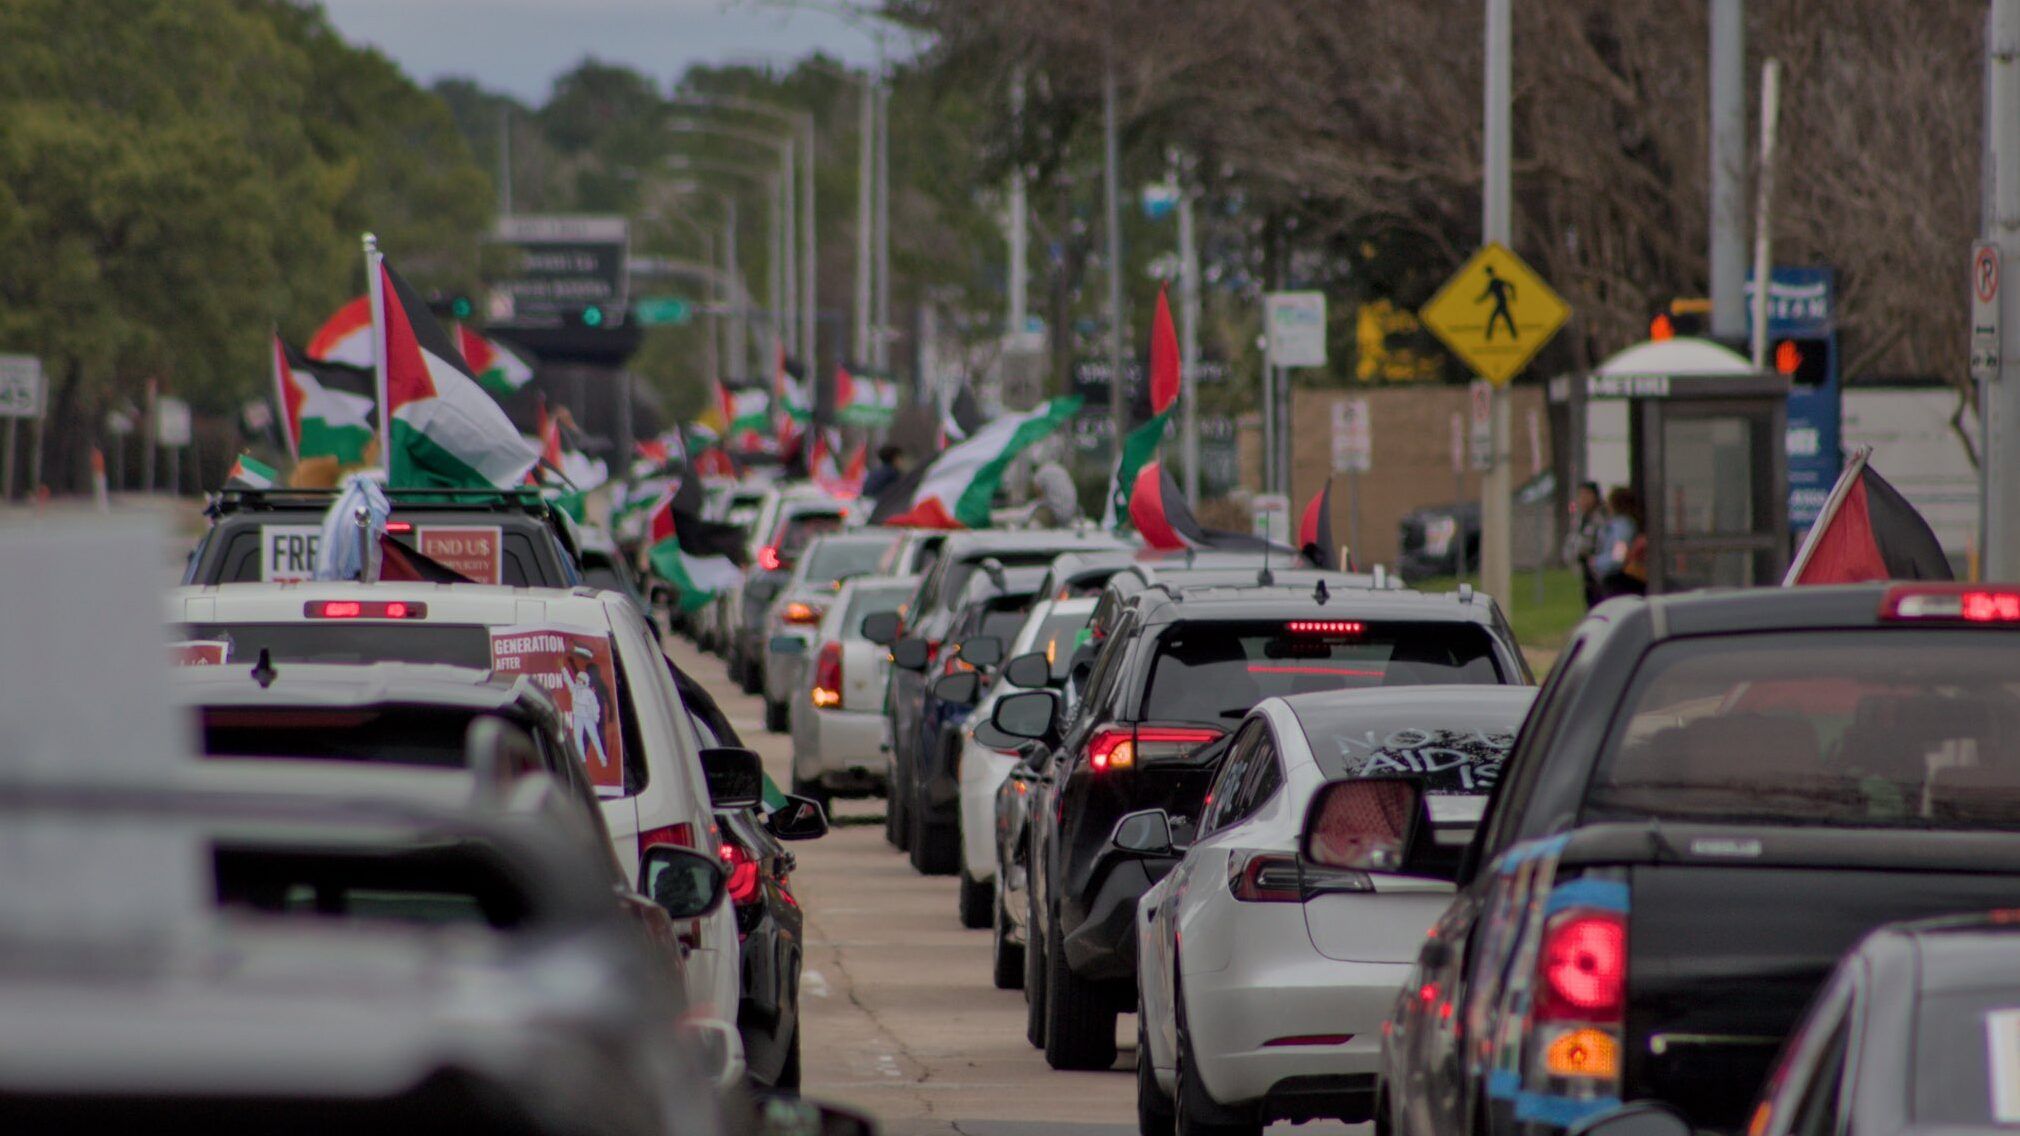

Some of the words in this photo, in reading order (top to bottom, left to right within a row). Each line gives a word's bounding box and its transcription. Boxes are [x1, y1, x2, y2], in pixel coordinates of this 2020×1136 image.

[426, 538, 463, 556] END
[494, 634, 566, 655] GENERATION
[495, 656, 521, 671] AFTER
[1331, 727, 1431, 754] NO
[1359, 747, 1471, 778] AID
